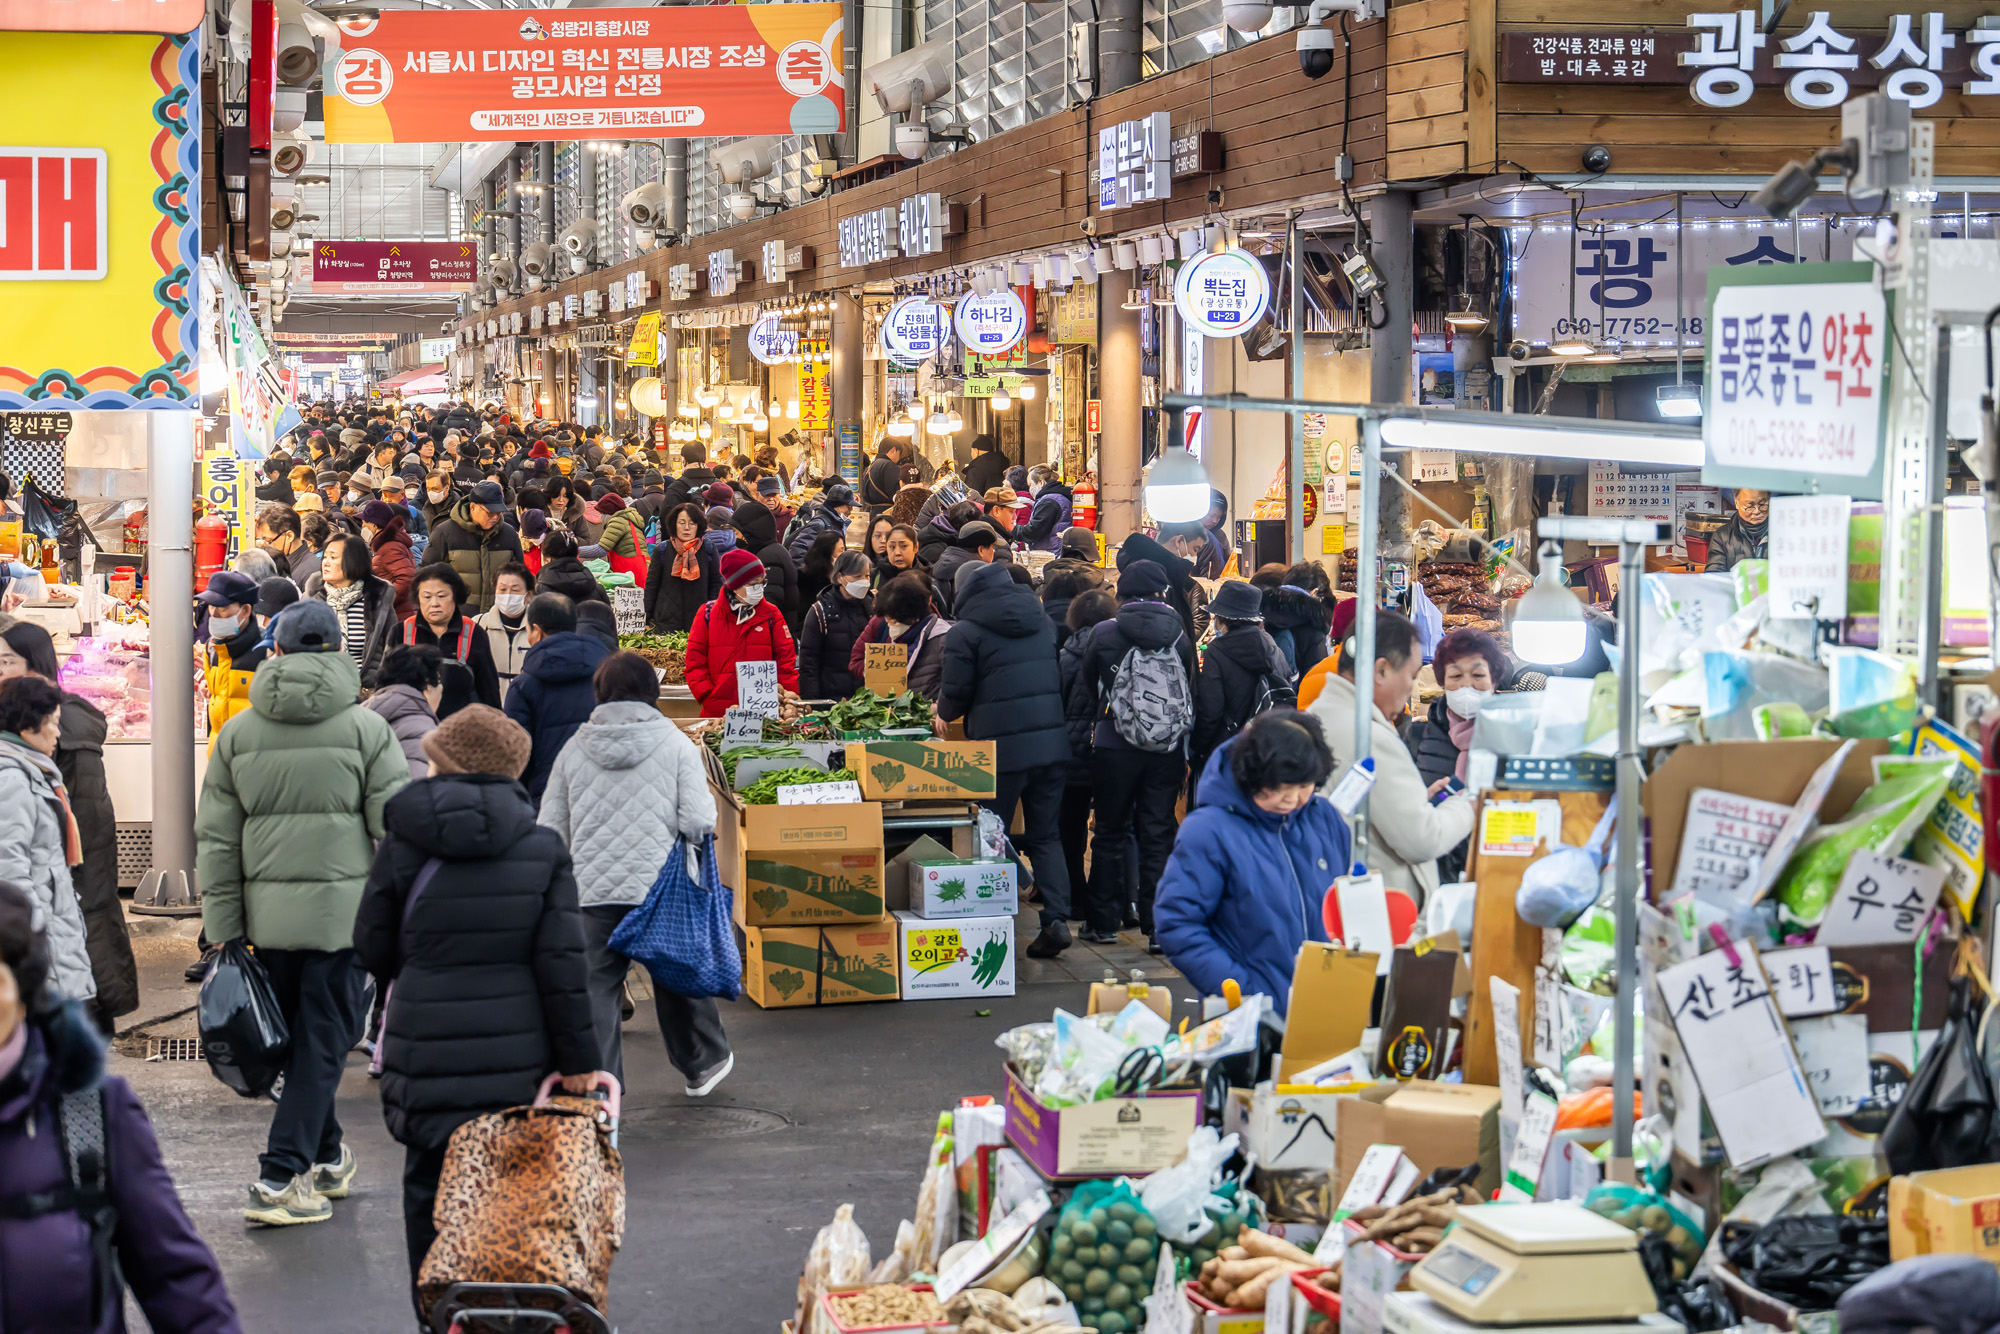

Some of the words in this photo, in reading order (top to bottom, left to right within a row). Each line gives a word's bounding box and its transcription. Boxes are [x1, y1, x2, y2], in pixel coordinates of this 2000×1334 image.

[551, 21, 592, 38] 청량리
[594, 20, 650, 37] 종합시장
[1630, 37, 1654, 56] 일체
[403, 50, 475, 73] 서울시
[484, 48, 555, 71] 디자인
[563, 47, 609, 71] 혁신
[617, 46, 712, 70] 전통시장
[719, 45, 766, 68] 조성
[786, 49, 822, 87] 축
[344, 59, 382, 97] 경
[511, 76, 607, 98] 공모사업
[614, 74, 662, 97] 선정
[544, 110, 595, 127] 시장으로
[905, 314, 935, 325] 진희네
[970, 307, 1012, 323] 하나김
[1213, 312, 1235, 320] 나-23
[896, 326, 943, 339] 덕성물산
[1823, 312, 1872, 406] 약초
[802, 376, 817, 428] 칼국수
[9, 417, 70, 434] 창신푸드
[1848, 875, 1925, 933] 우슬
[933, 934, 958, 946] 갈전
[910, 947, 969, 962] 오이고추
[1675, 964, 1769, 1021] 산초
